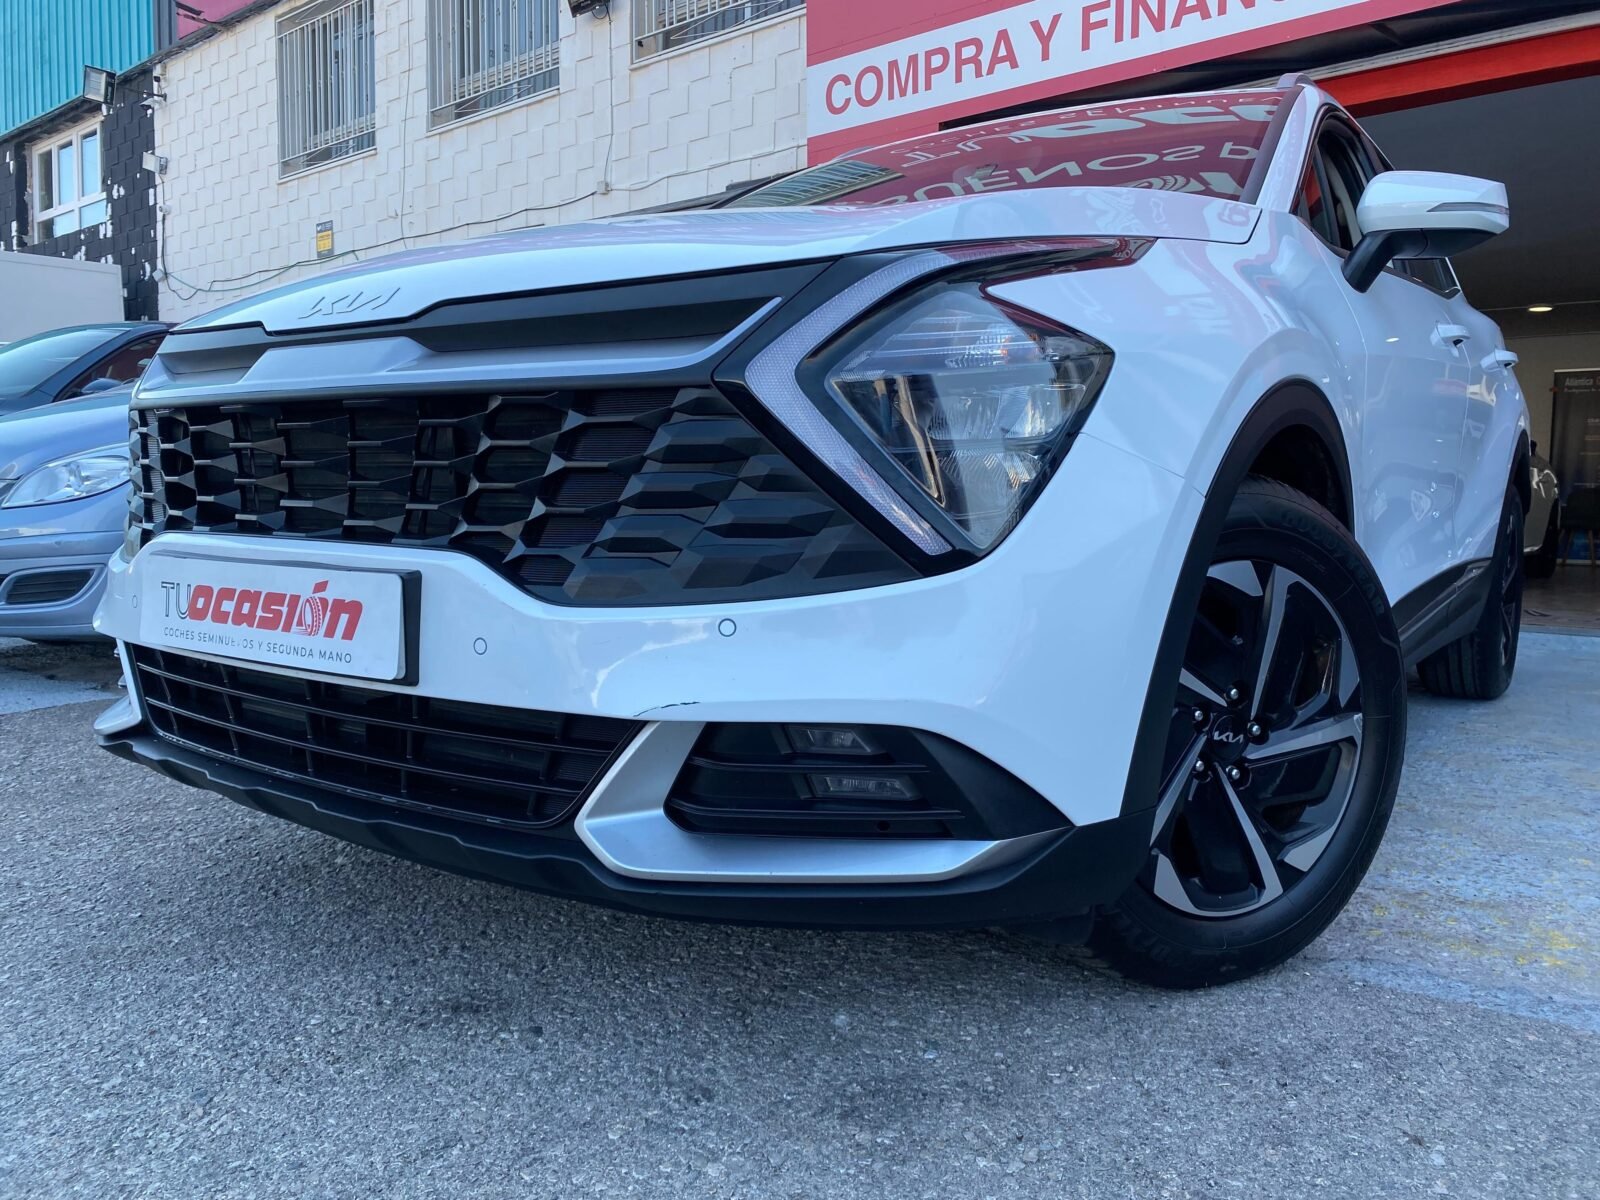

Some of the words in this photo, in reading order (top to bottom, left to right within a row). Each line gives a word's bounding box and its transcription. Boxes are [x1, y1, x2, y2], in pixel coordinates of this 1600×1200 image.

[825, 28, 1019, 116] COMPRA
[1029, 12, 1063, 62] Y
[1081, 0, 1286, 52] FINA
[298, 287, 401, 320] KIA
[163, 626, 196, 641] COCHES
[258, 641, 264, 652] Y
[266, 641, 315, 659] SEGUNDA
[318, 648, 353, 664] MANO
[1213, 730, 1244, 744] KIA
